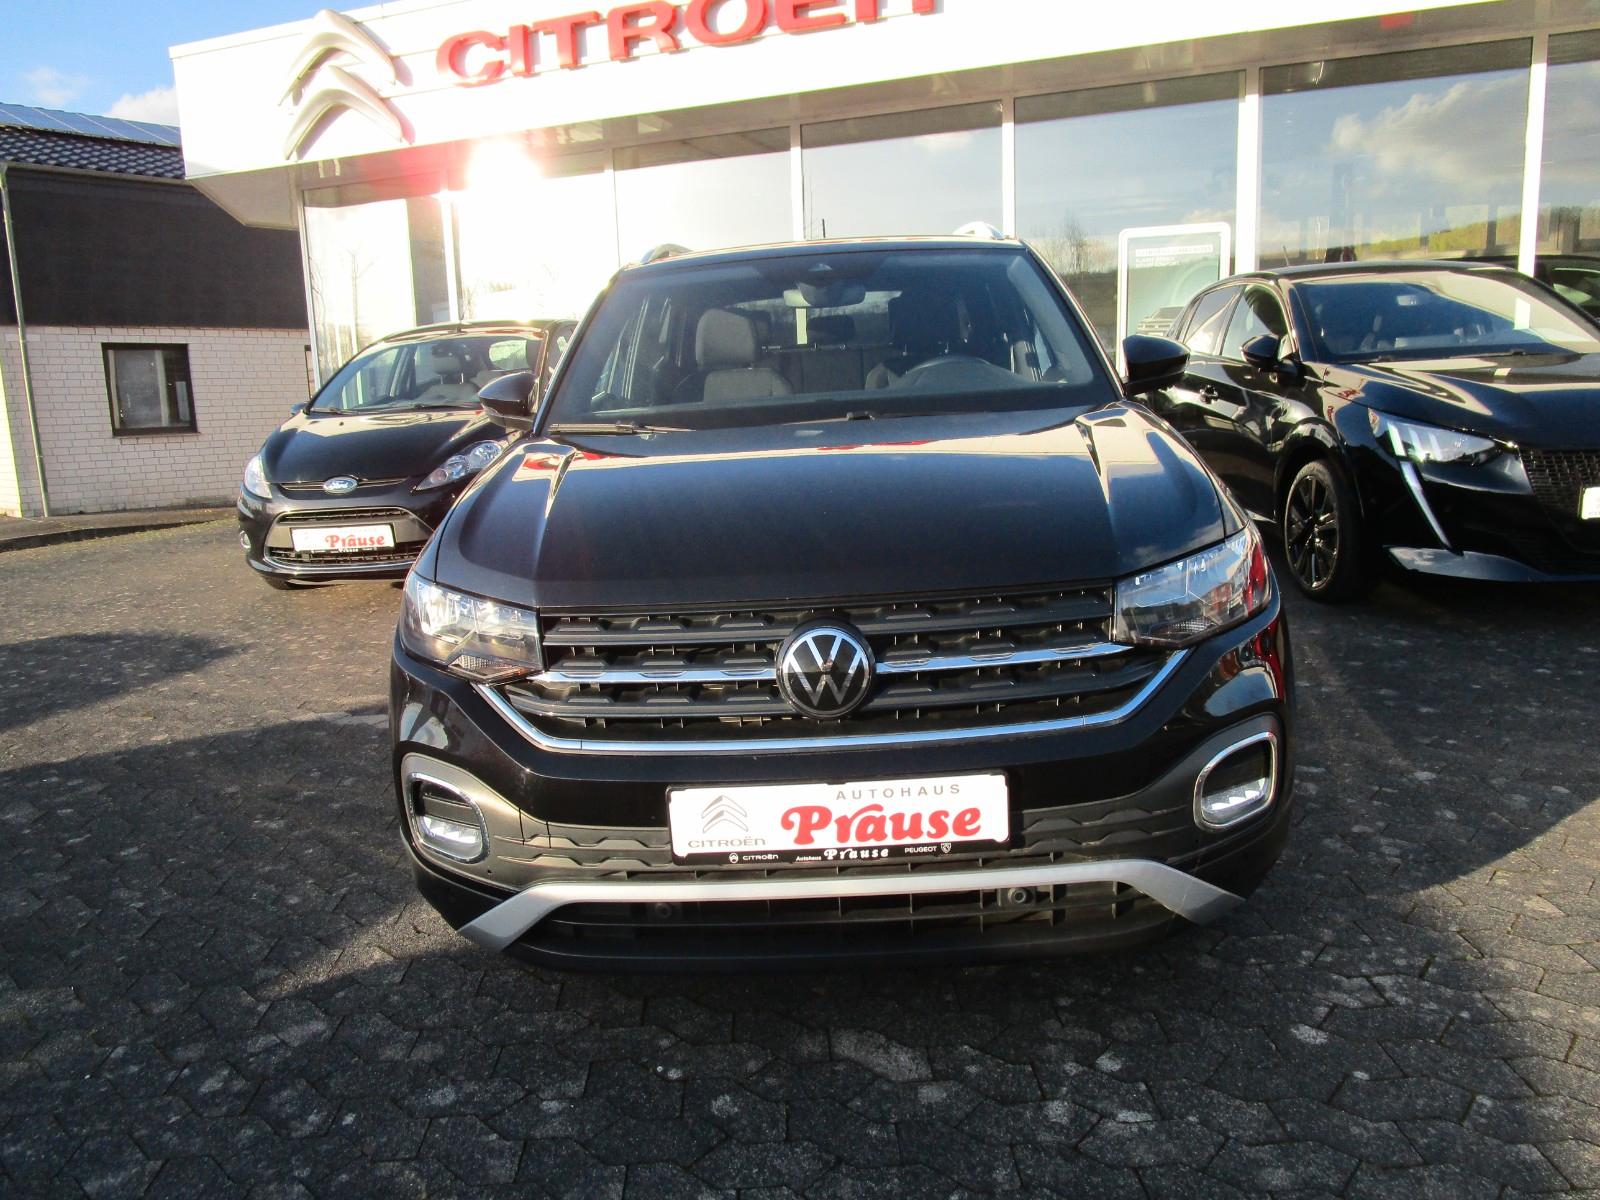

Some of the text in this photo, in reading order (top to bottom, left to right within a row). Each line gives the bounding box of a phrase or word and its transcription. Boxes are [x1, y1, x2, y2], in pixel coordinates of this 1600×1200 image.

[325, 535, 385, 548] Prause
[836, 784, 962, 801] AUTOHAUS
[780, 804, 981, 845] Prause
[823, 847, 889, 860] Prause
[904, 845, 937, 855] PEUGEOT
